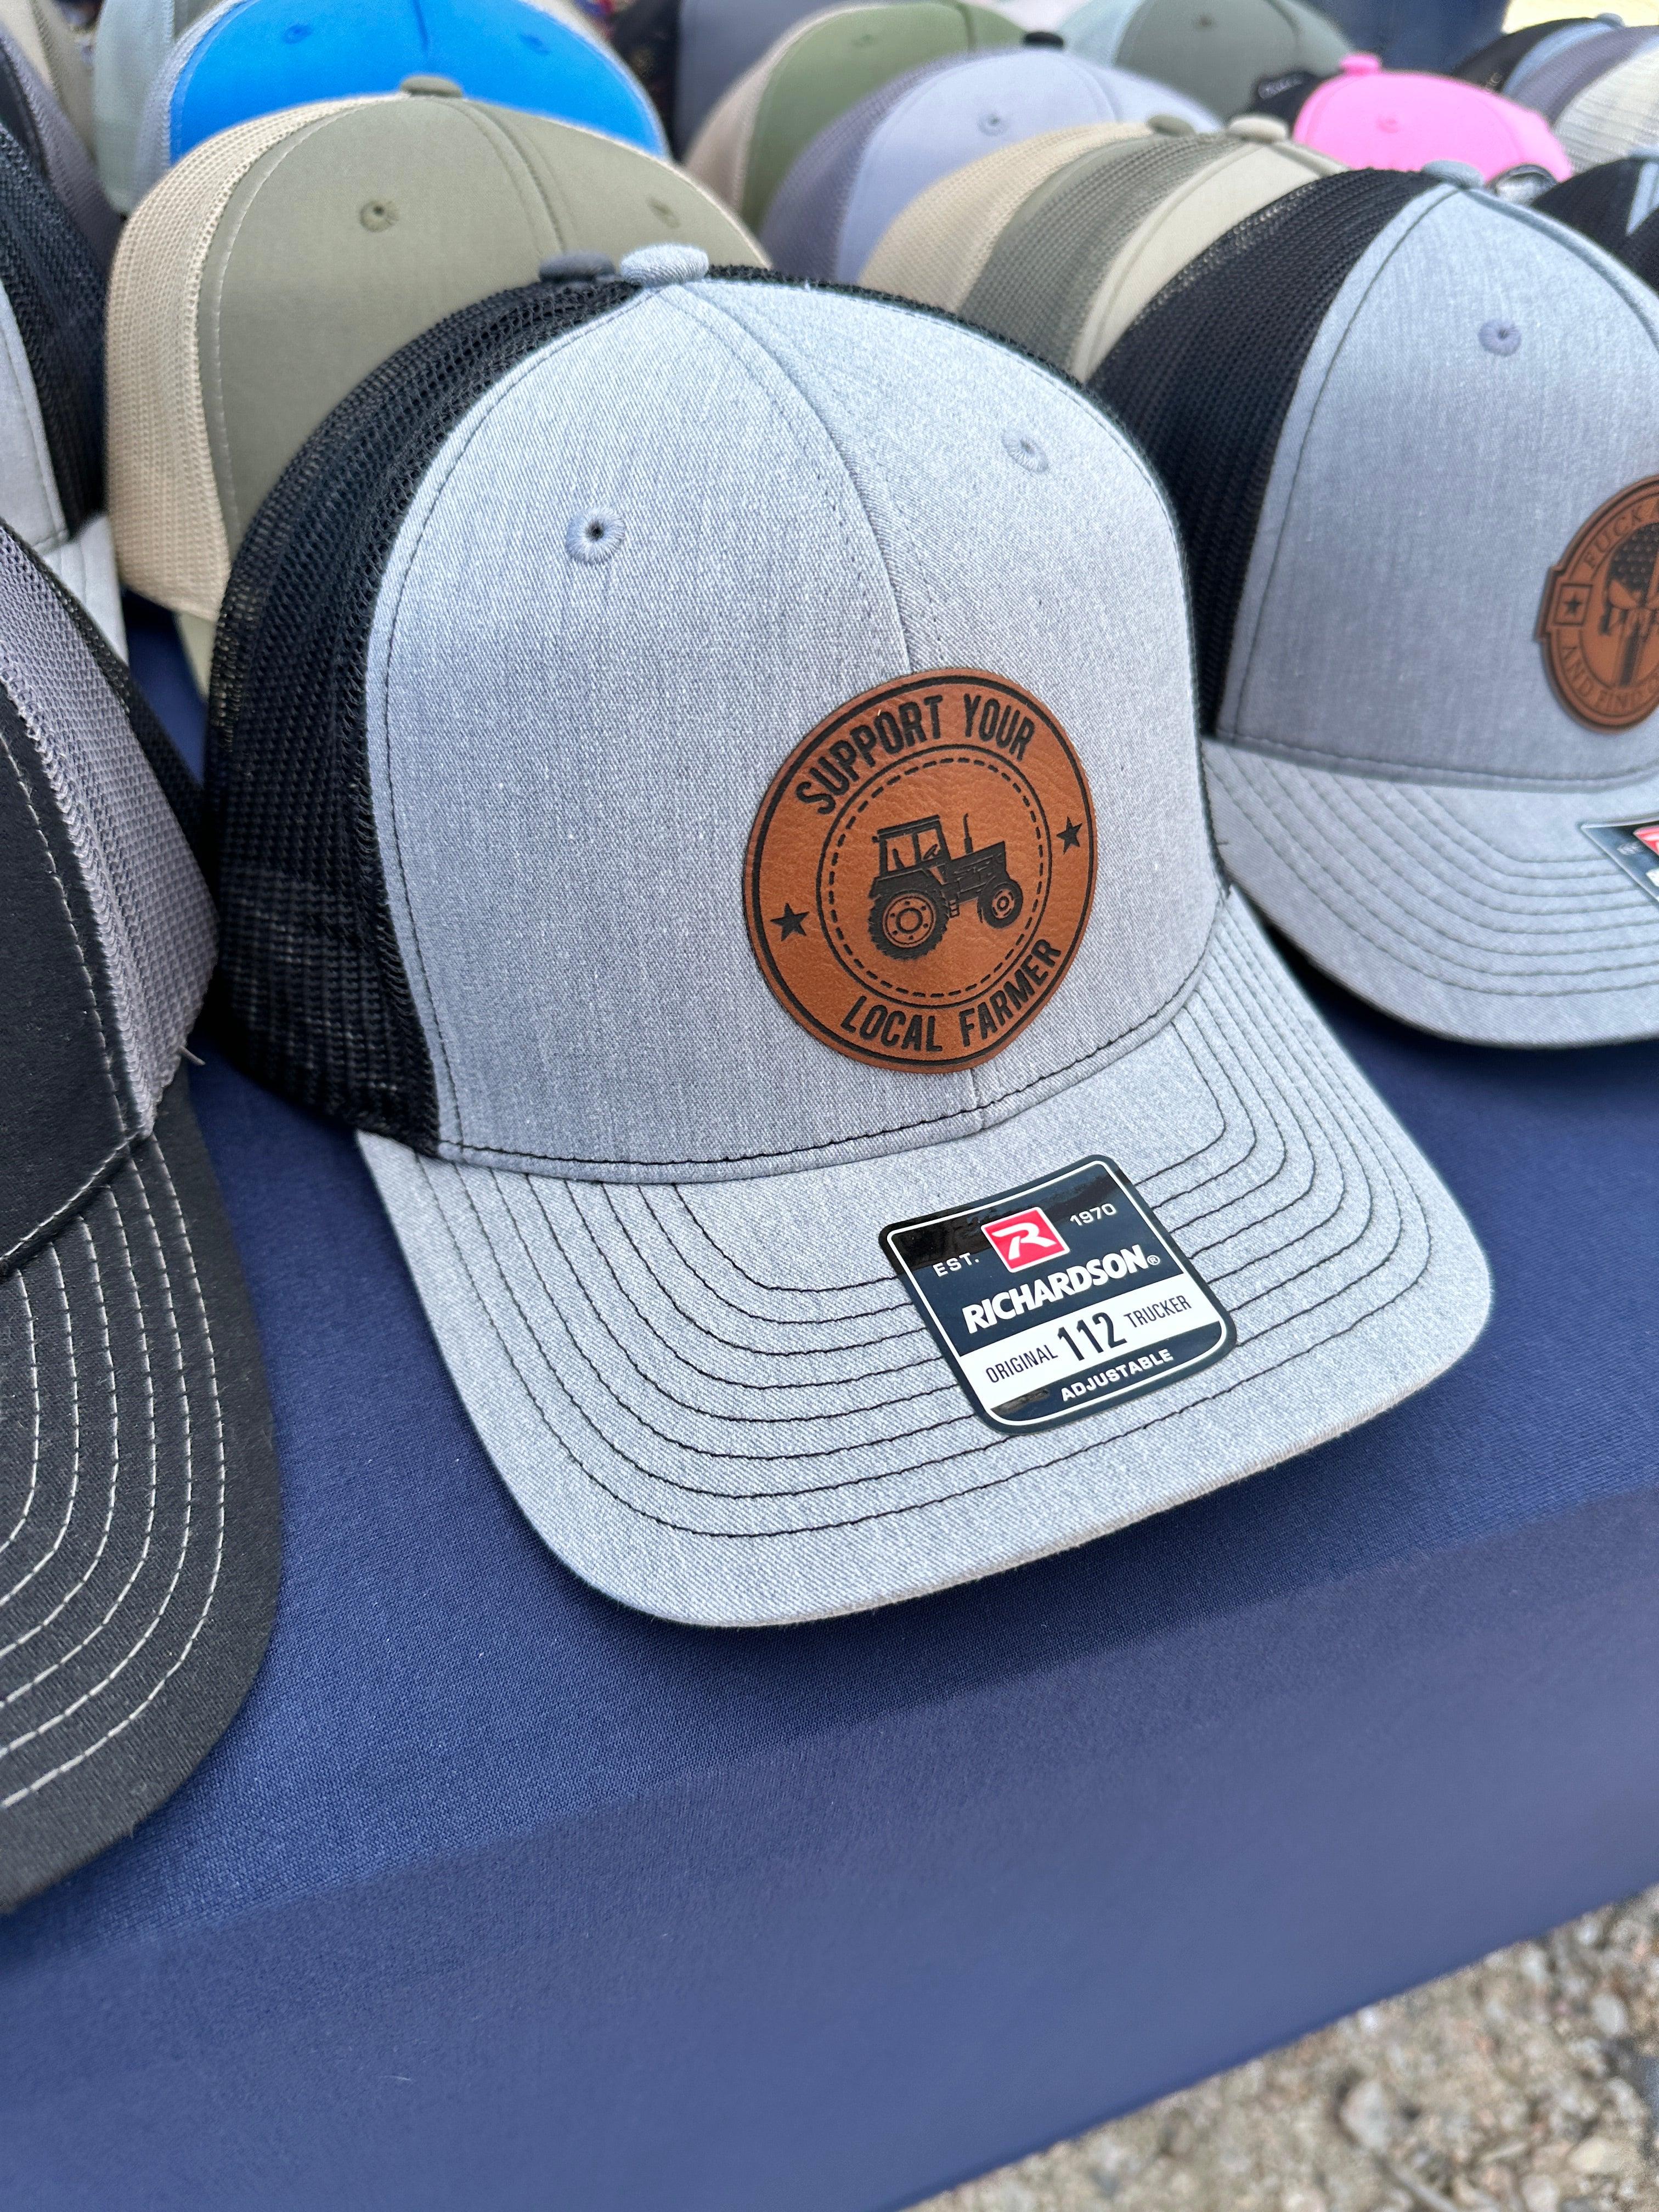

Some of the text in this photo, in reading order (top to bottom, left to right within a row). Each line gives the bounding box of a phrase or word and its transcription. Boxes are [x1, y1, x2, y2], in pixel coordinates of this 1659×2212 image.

[1583, 505, 1643, 568] FUCK
[796, 693, 1035, 815] SUPPORT YOUR
[841, 938, 1062, 1052] LOCAL FARMER
[933, 1203, 1117, 1277] EST. 1970
[986, 1295, 1193, 1383] ORIGINAL 112 TRUCKER
[1061, 1348, 1173, 1402] ADJUSTABLE
